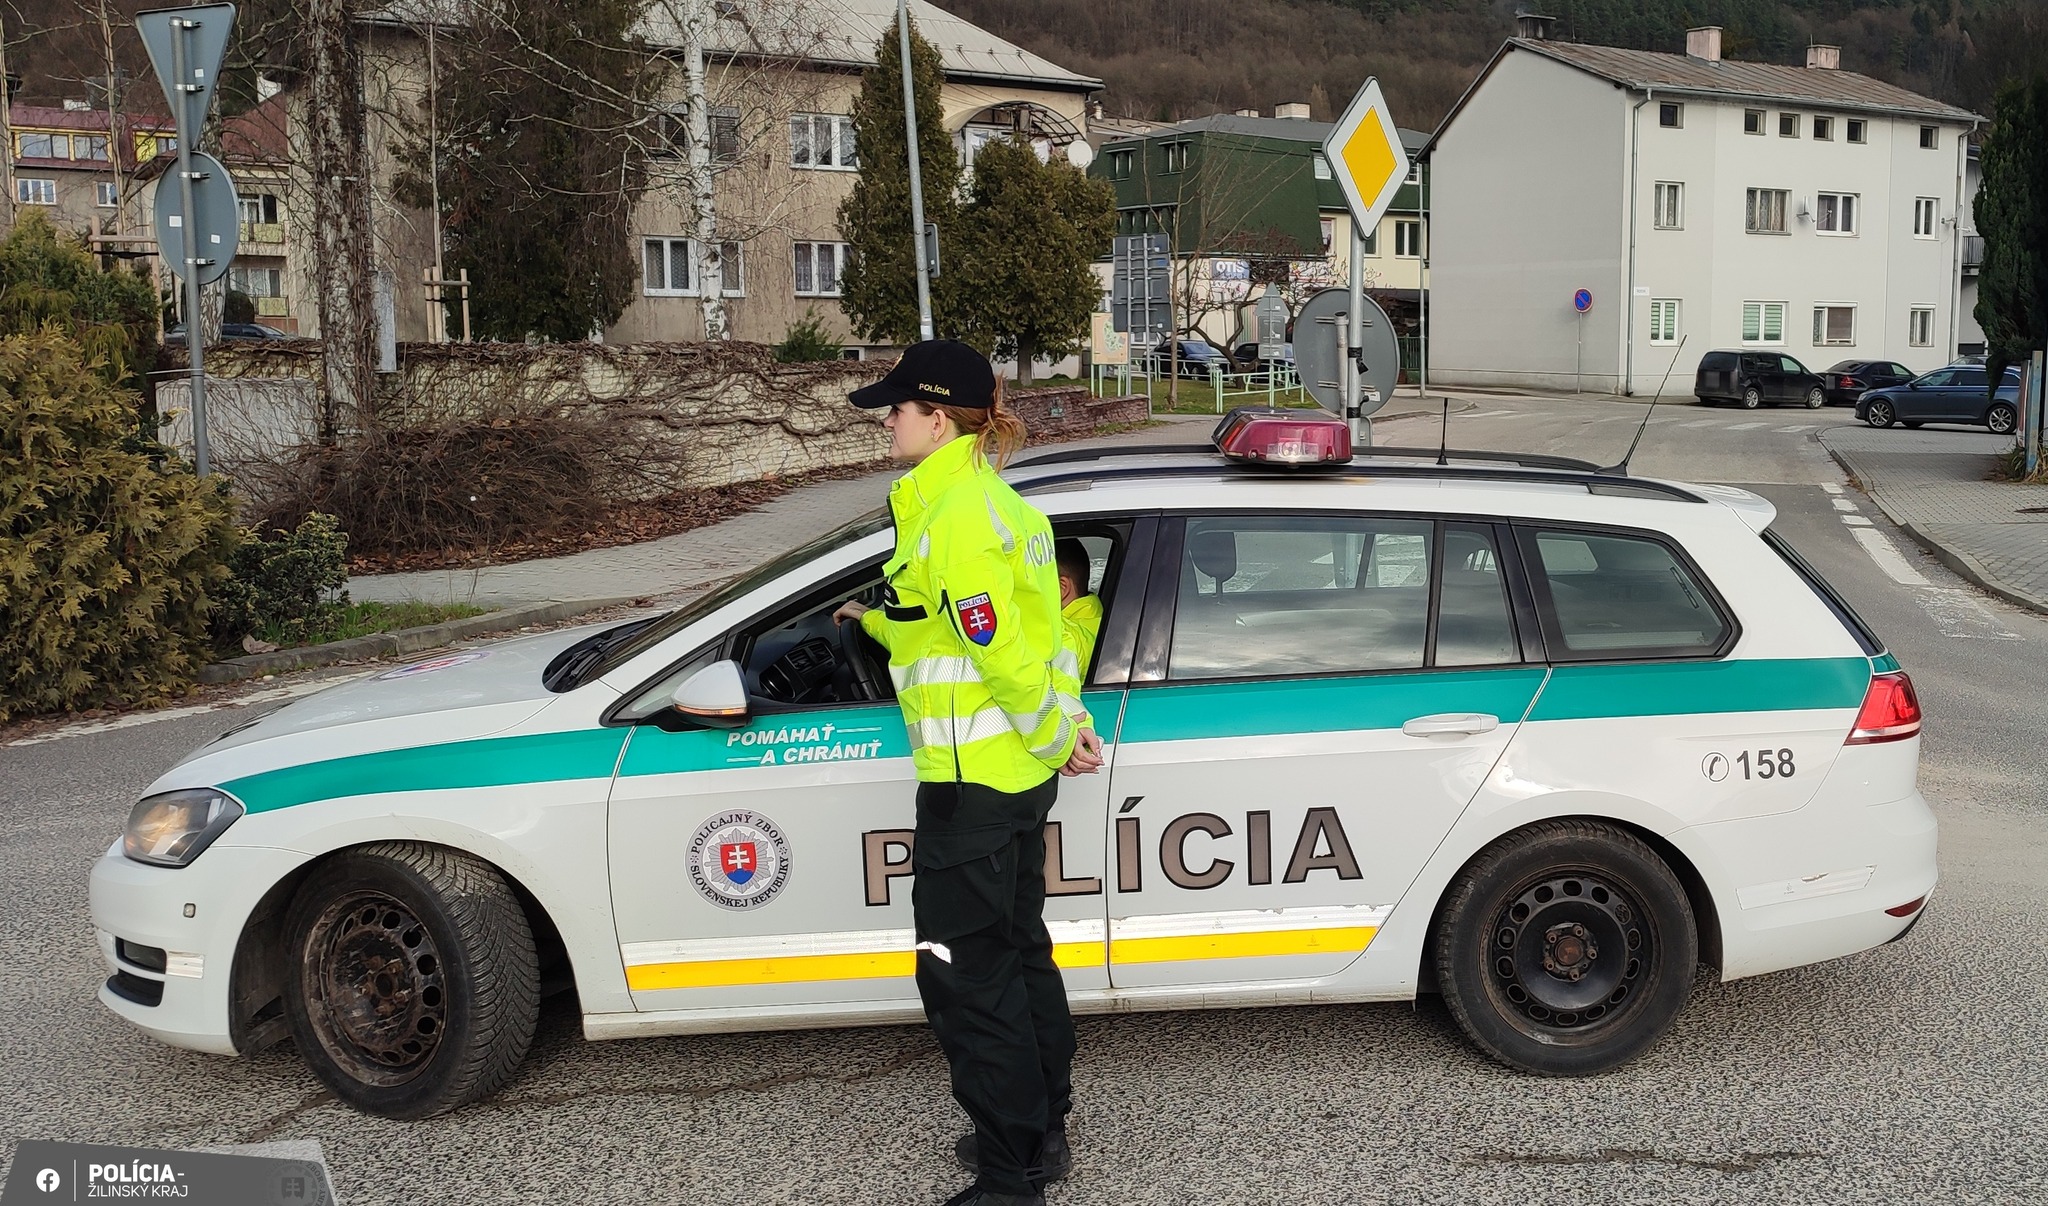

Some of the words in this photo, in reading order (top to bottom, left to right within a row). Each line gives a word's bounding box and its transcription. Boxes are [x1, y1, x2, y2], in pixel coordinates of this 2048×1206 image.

[918, 383, 951, 396] POLÍCIA
[959, 596, 988, 609] POLÍCIA
[727, 722, 836, 747] POMÁHAŤ
[760, 749, 777, 765] A
[783, 739, 883, 763] CHRÁNIŤ
[1736, 748, 1796, 780] 158
[690, 811, 753, 855] POLICAJNÝ
[754, 818, 784, 848] ZBOR
[861, 796, 1364, 907] PLÍCIA
[690, 865, 749, 908] SLOVENSKEJ
[750, 856, 789, 906] REPUBLIKY
